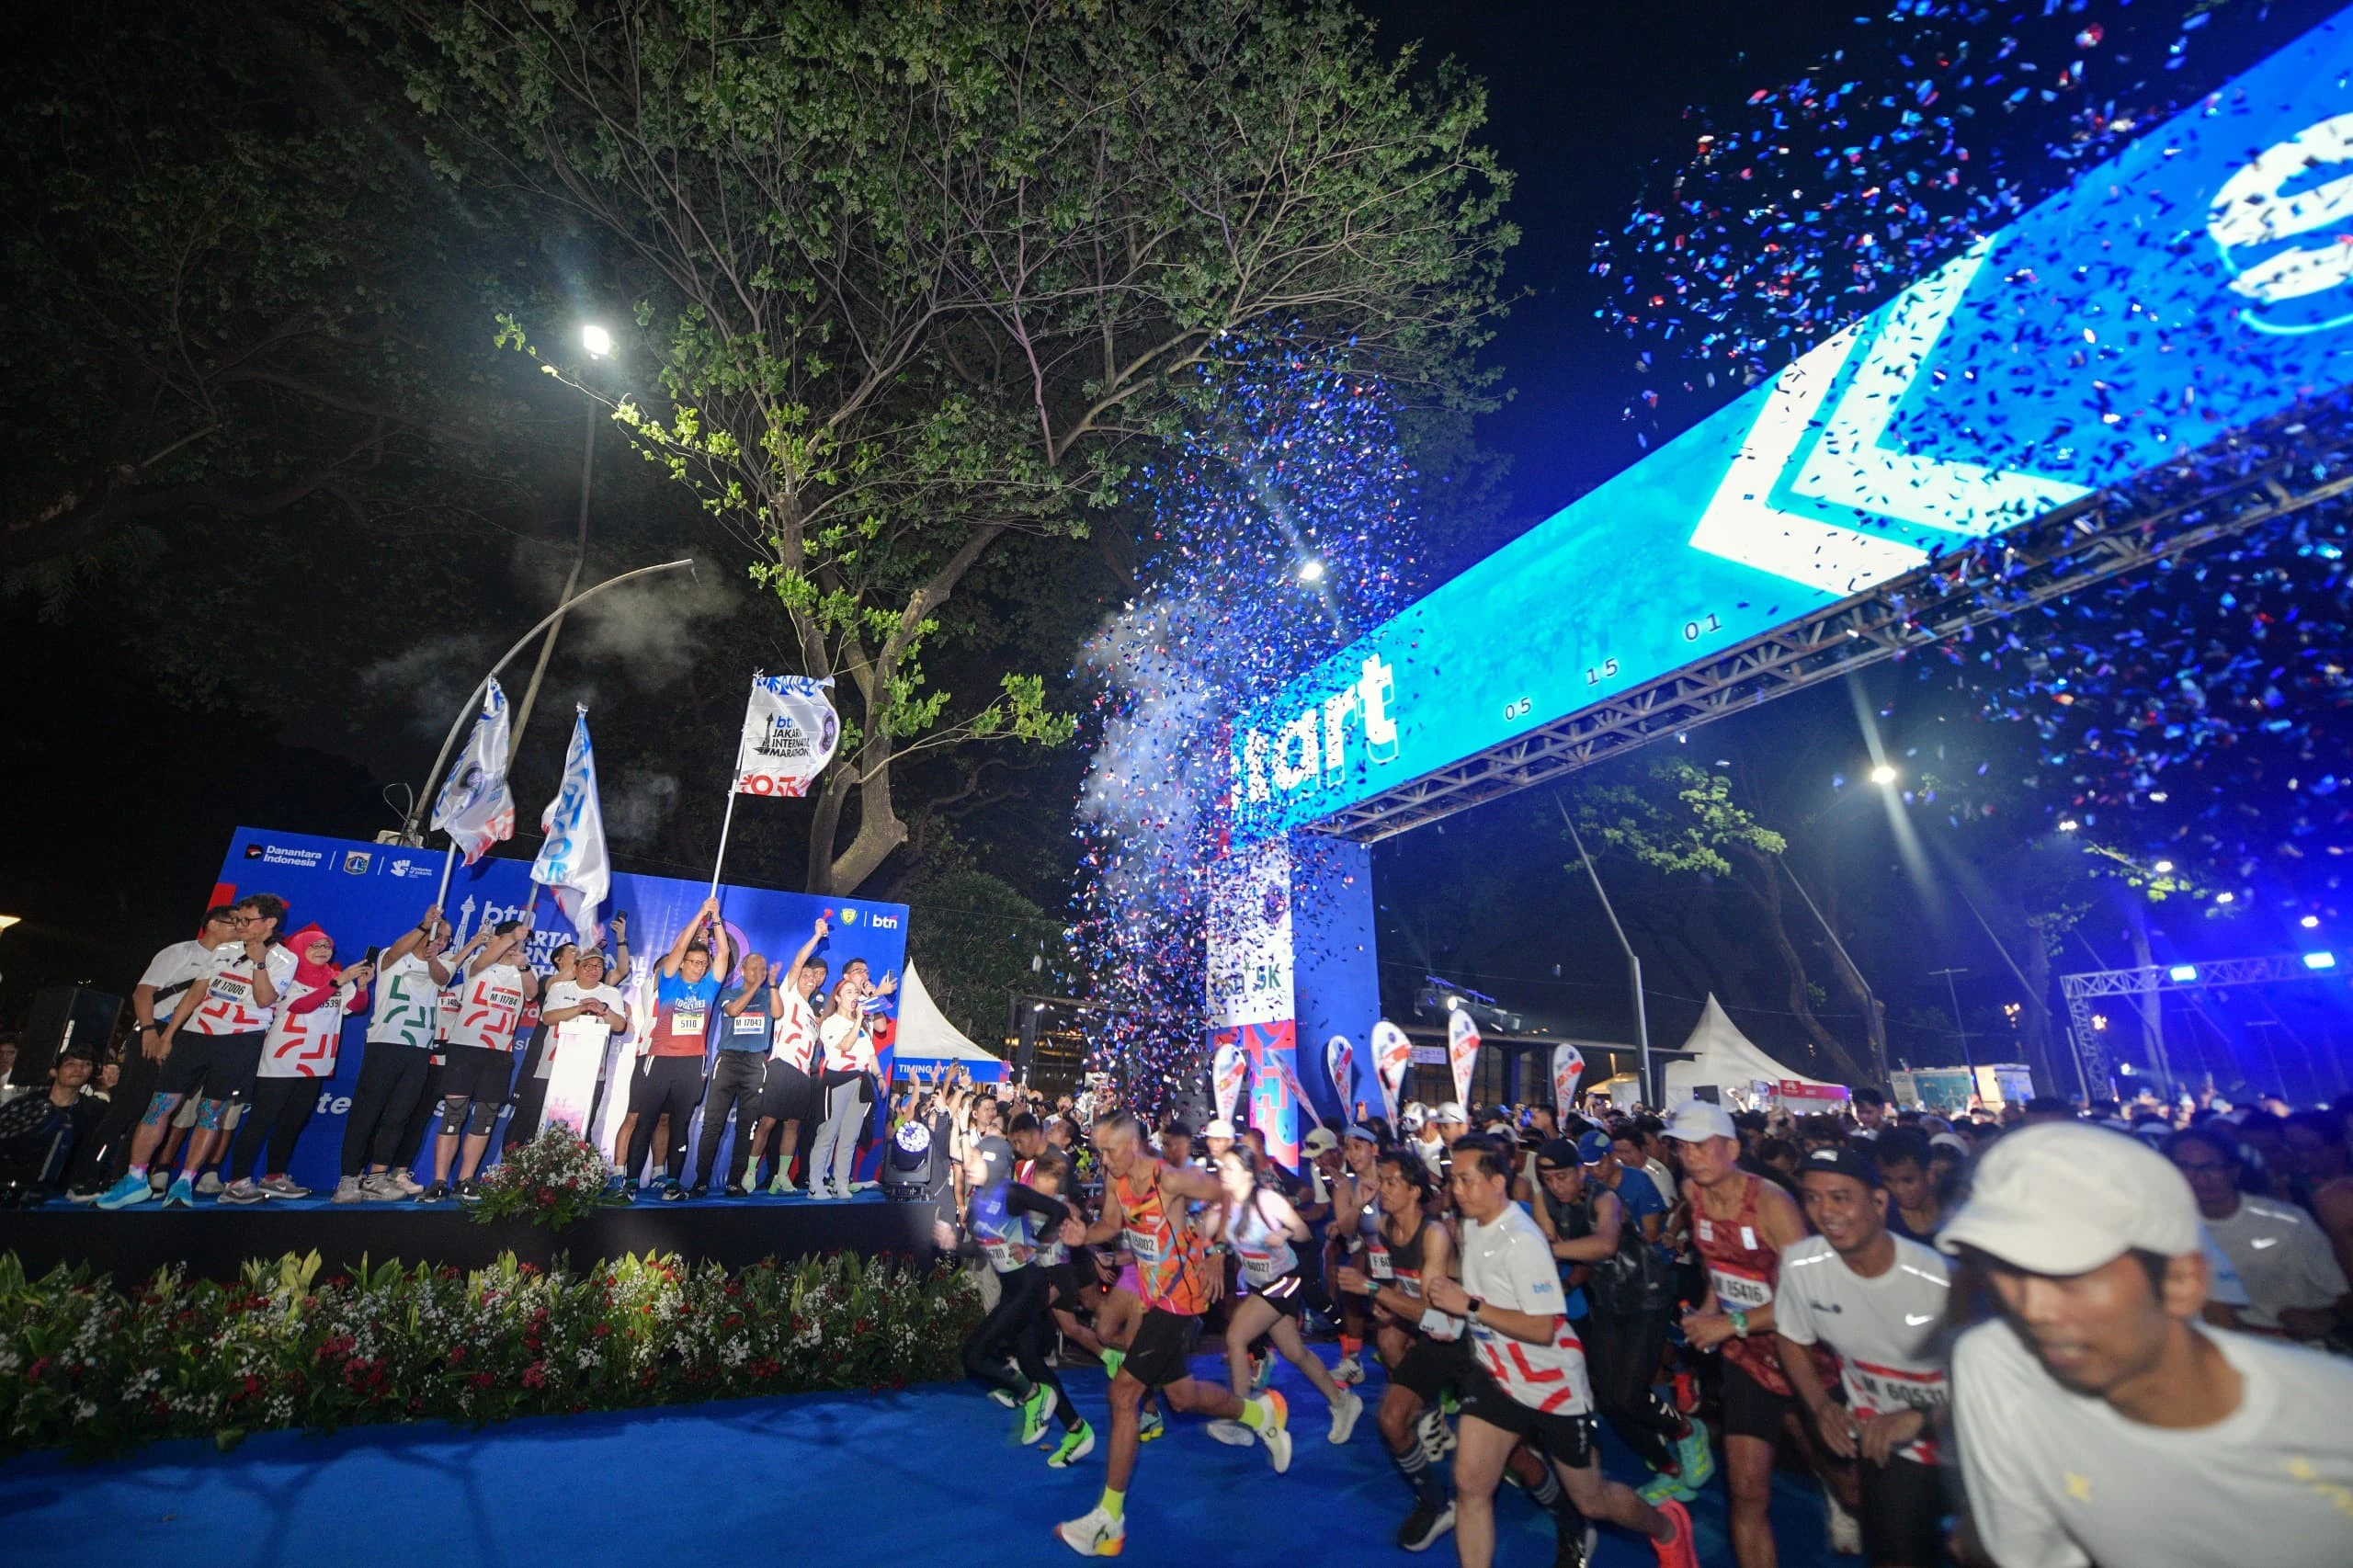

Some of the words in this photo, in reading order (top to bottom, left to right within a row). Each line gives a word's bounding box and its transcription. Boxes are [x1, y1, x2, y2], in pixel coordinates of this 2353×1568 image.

[1505, 697, 1531, 721] 05
[1586, 658, 1618, 686] 15
[1684, 613, 1722, 641] 01
[776, 715, 794, 729] bt
[1230, 653, 1398, 811] tart
[266, 845, 322, 859] Danantara
[263, 854, 317, 868] Indonesia
[872, 914, 898, 929] btn
[1256, 962, 1282, 990] 5K
[210, 978, 219, 988] M
[221, 981, 246, 995] 17006
[490, 993, 496, 1001] M
[499, 994, 518, 1006] 11784
[680, 1019, 697, 1028] 5110
[744, 1018, 762, 1027] 17043
